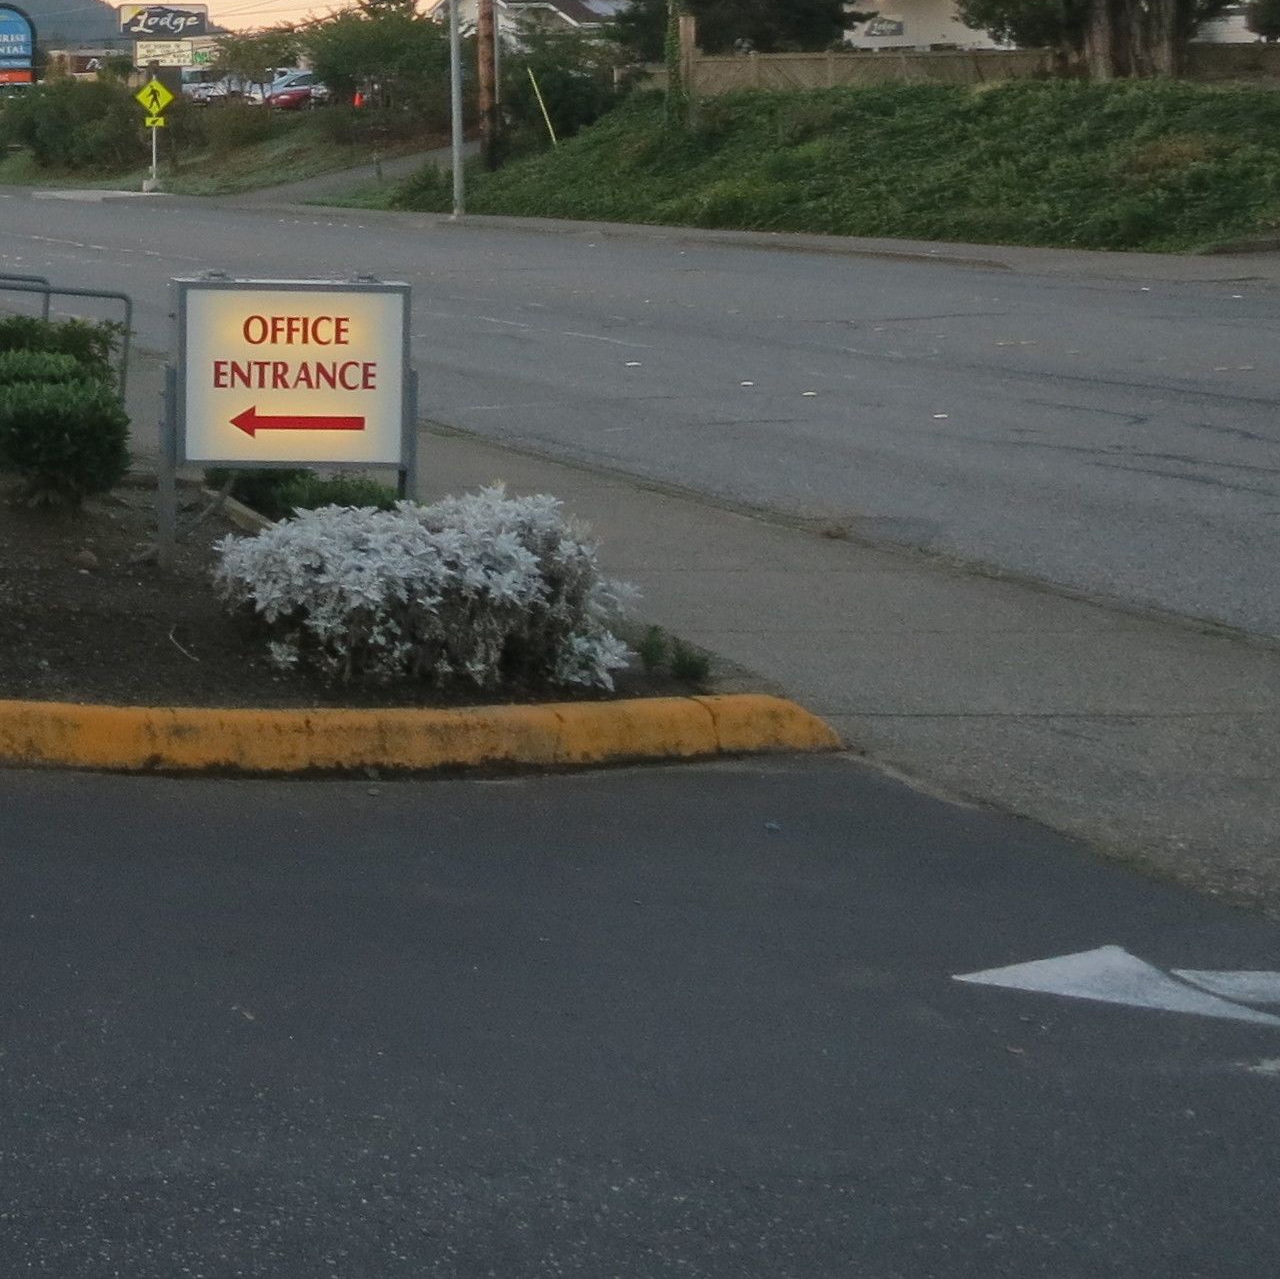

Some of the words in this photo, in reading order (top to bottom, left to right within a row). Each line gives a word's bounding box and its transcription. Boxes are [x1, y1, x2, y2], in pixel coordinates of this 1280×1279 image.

[130, 12, 200, 34] Lodge
[242, 314, 350, 346] OFFICE
[212, 360, 378, 391] ENTRANCE
